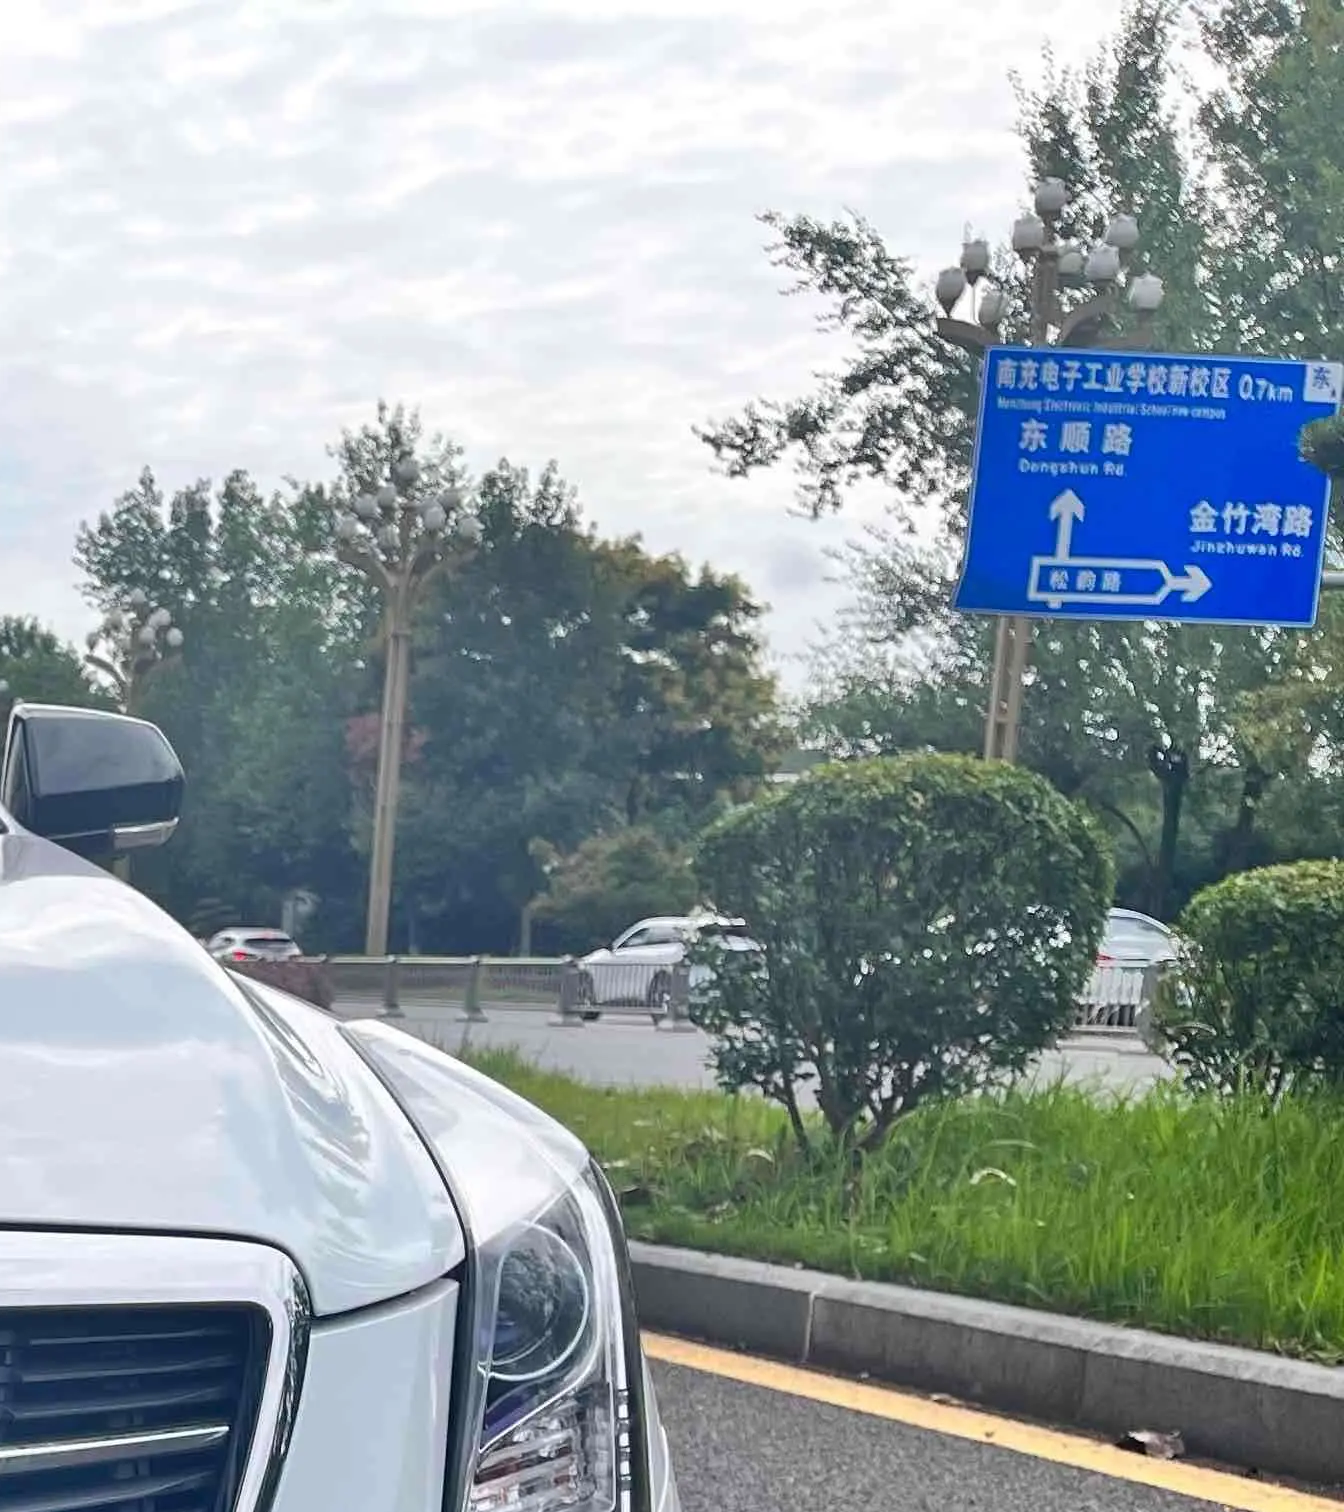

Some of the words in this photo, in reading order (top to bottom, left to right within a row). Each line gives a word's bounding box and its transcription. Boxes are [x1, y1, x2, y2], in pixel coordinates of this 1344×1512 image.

[996, 358, 1232, 399] 南充电子工业学校新校区
[1238, 374, 1293, 402] 0.7km
[1018, 418, 1133, 456] 东顺路
[1019, 457, 1099, 477] Dongshun
[1189, 500, 1312, 538] 金竹湾路
